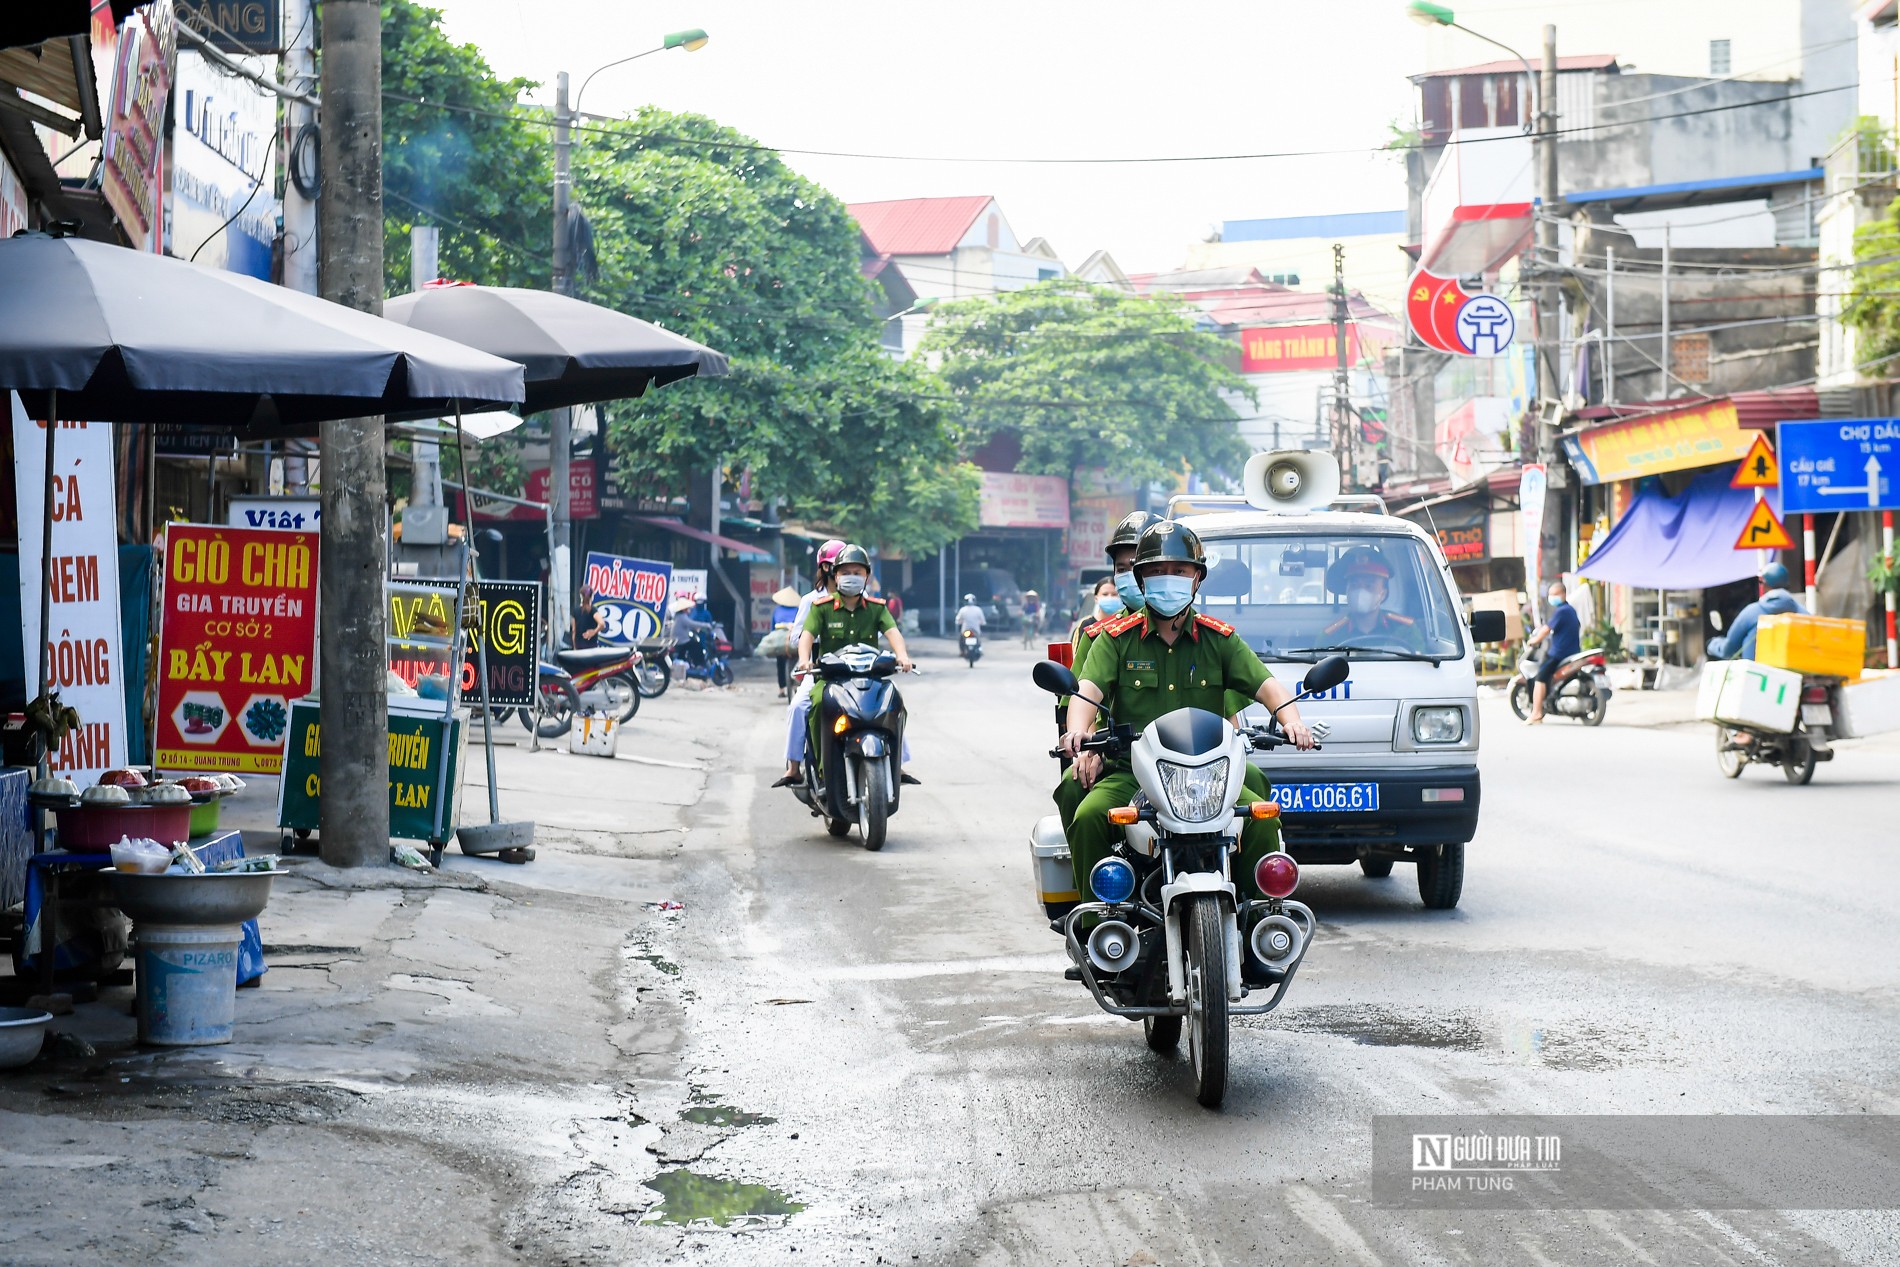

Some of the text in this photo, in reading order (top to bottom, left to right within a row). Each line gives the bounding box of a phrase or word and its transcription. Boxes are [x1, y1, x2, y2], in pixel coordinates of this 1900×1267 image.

[1250, 337, 1282, 360] VÀNG
[1284, 334, 1325, 359] THÀNH
[1840, 425, 1870, 441] CHỢ
[1873, 442, 1891, 453] km
[1811, 474, 1830, 486] km
[173, 533, 311, 589] GIÒ CHẢ
[588, 560, 634, 599] DOÃN
[634, 572, 667, 612] THỌ
[176, 593, 213, 613] GIA
[204, 618, 272, 639] CƠ SỞ 2
[598, 604, 652, 643] 30
[239, 652, 305, 685] LAN
[304, 723, 320, 758] GI
[194, 755, 216, 766] QUANG
[219, 756, 241, 767] TRUNG
[394, 782, 430, 808] LAN
[184, 952, 232, 966] PIZARO
